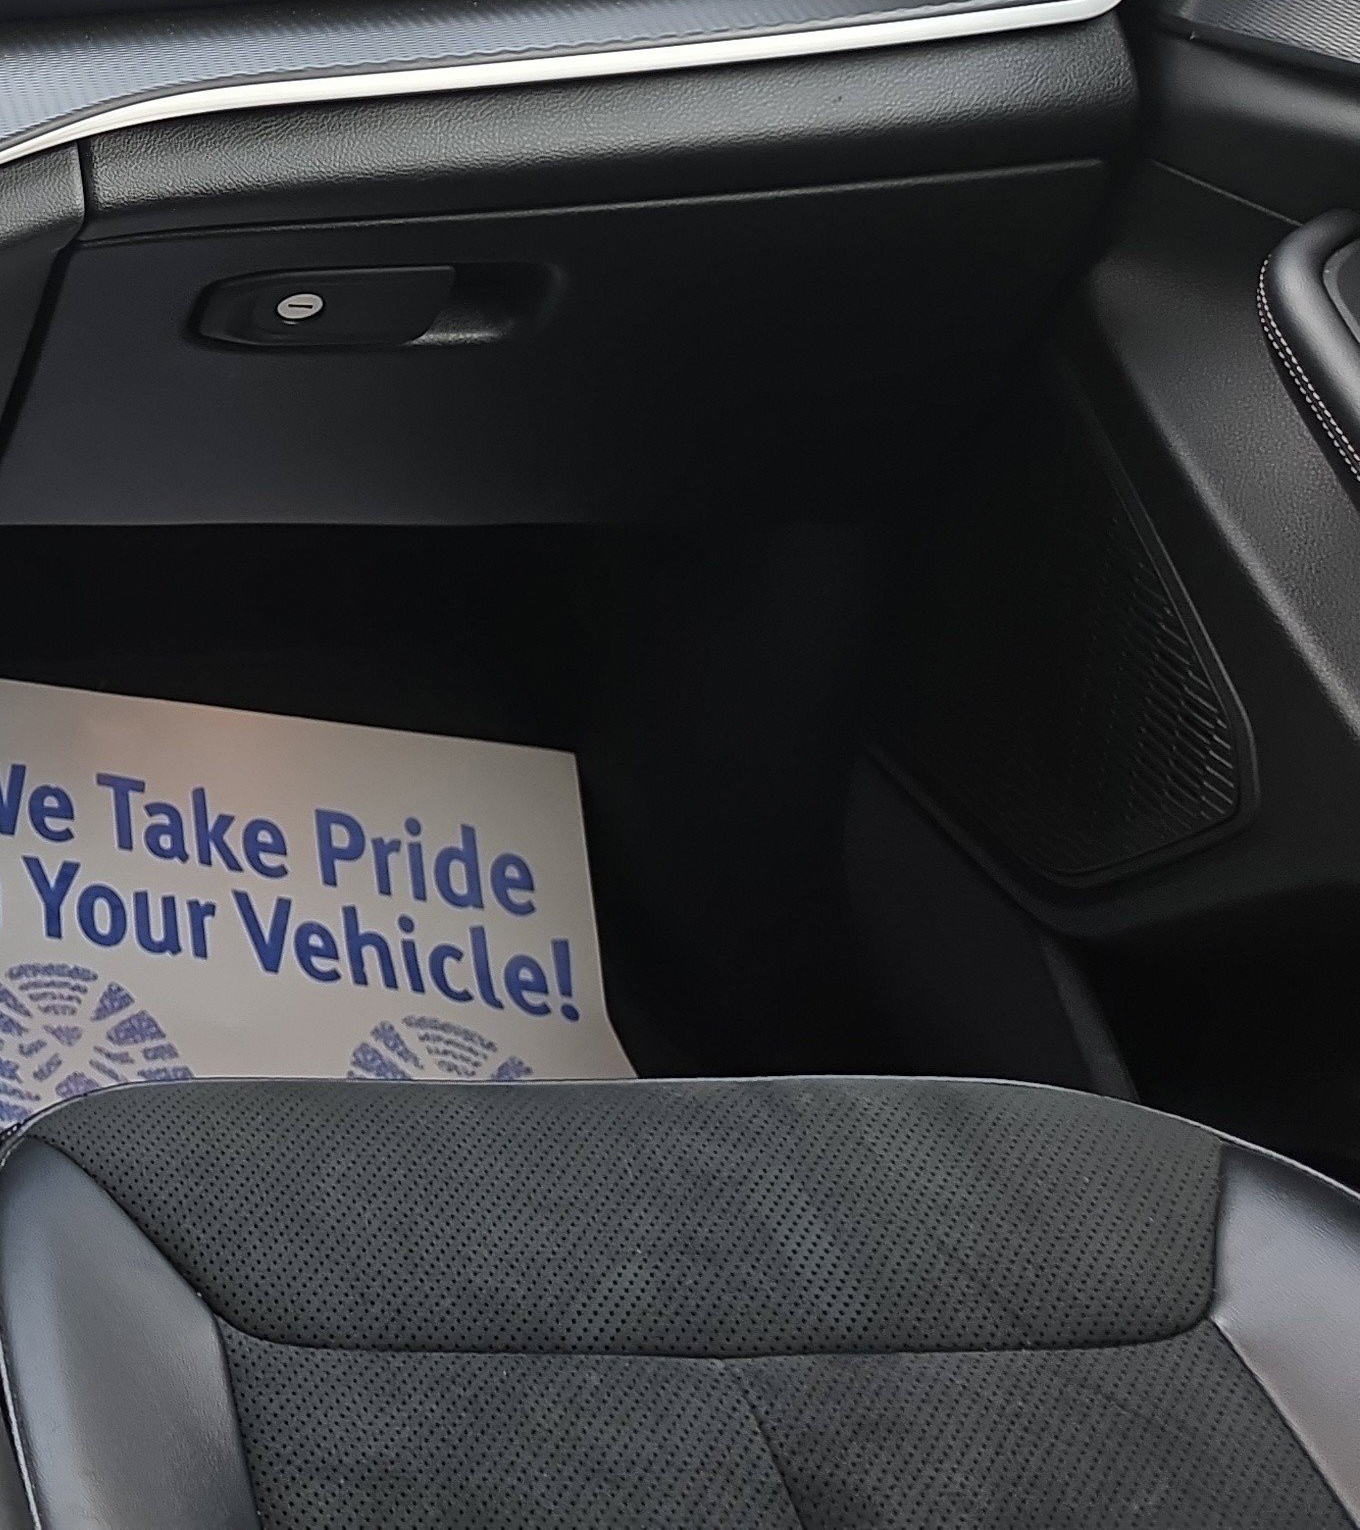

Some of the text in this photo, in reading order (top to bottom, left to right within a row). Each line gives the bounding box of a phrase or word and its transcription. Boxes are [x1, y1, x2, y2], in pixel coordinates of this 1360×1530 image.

[94, 771, 289, 880] Take
[312, 807, 536, 918] Pride
[20, 854, 216, 961] Your
[231, 887, 582, 1025] Vehicle!
